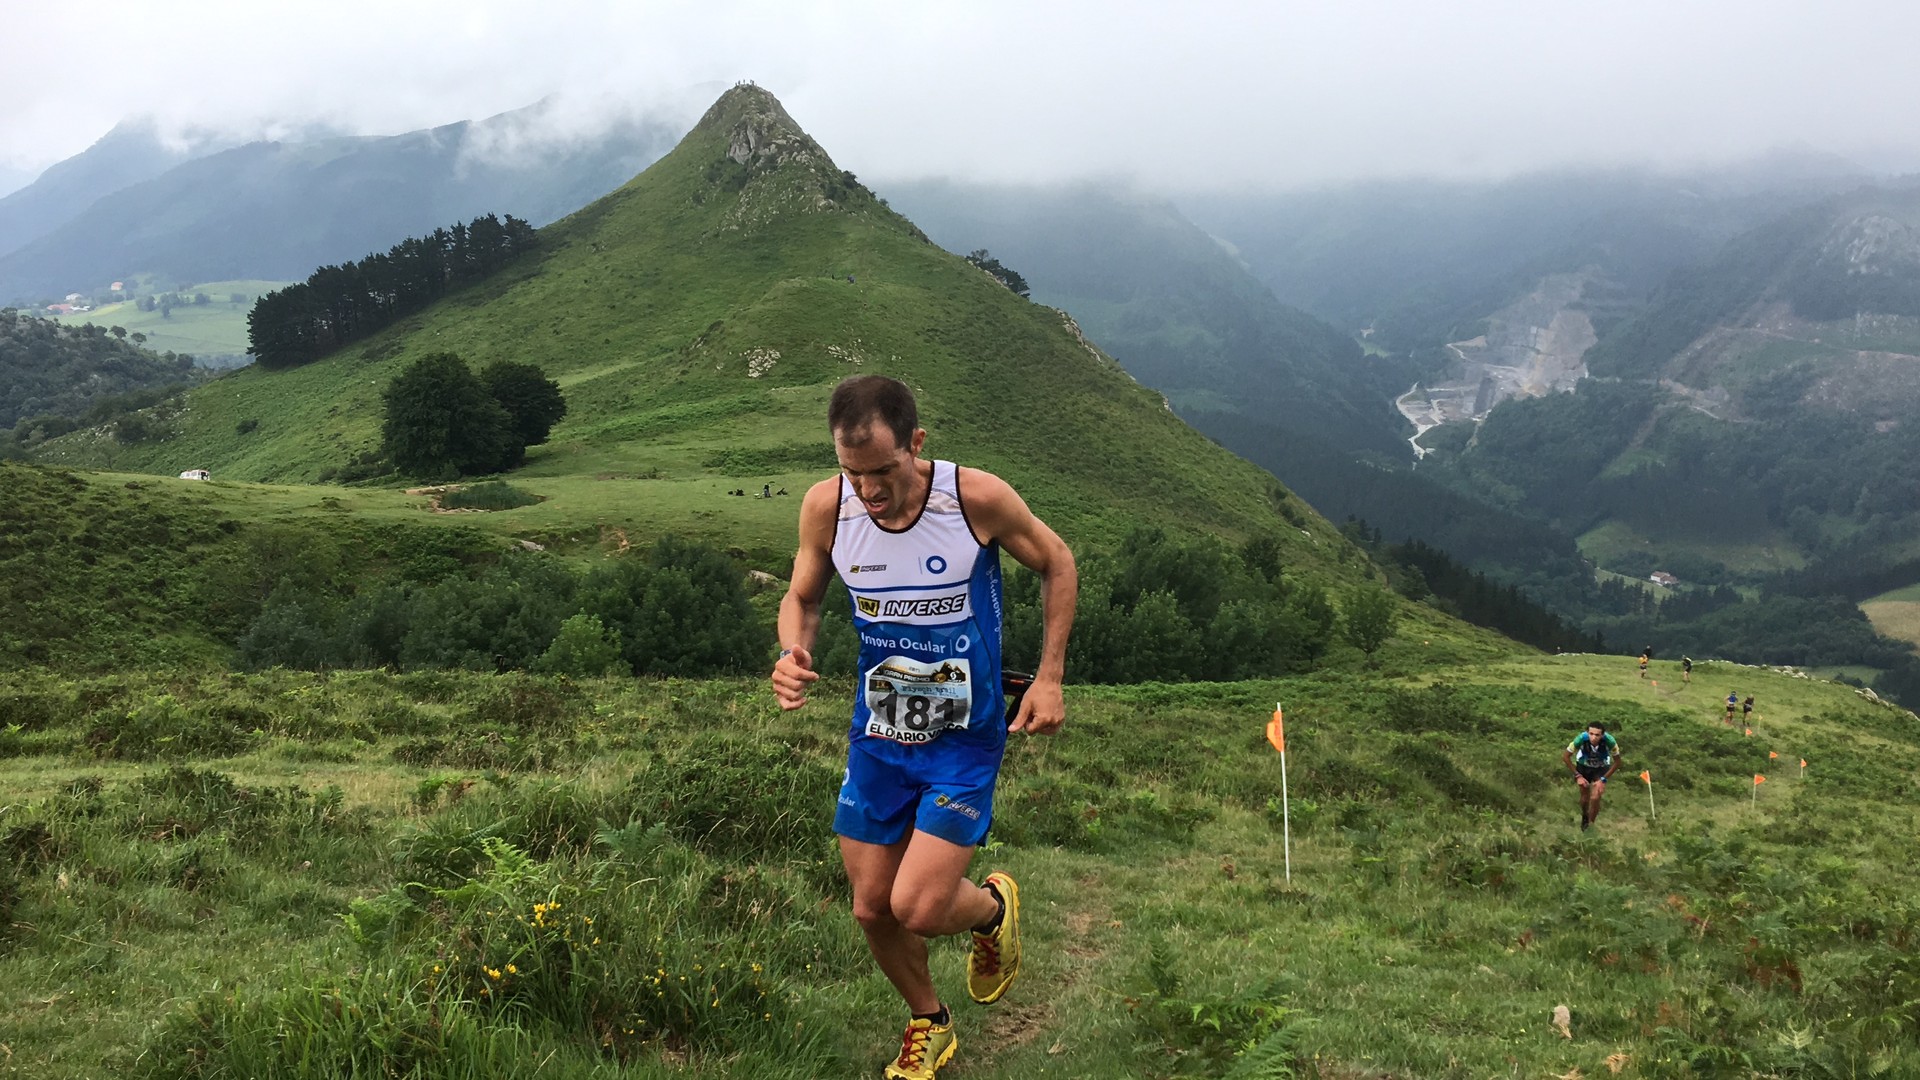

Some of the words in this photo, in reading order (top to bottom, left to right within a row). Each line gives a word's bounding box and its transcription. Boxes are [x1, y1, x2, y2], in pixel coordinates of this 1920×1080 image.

[883, 592, 967, 617] INVERSE
[899, 637, 946, 654] Ocular
[878, 694, 954, 730] 181
[870, 724, 883, 735] EL
[886, 727, 926, 742] DARIO
[947, 802, 980, 820] NVERSE
